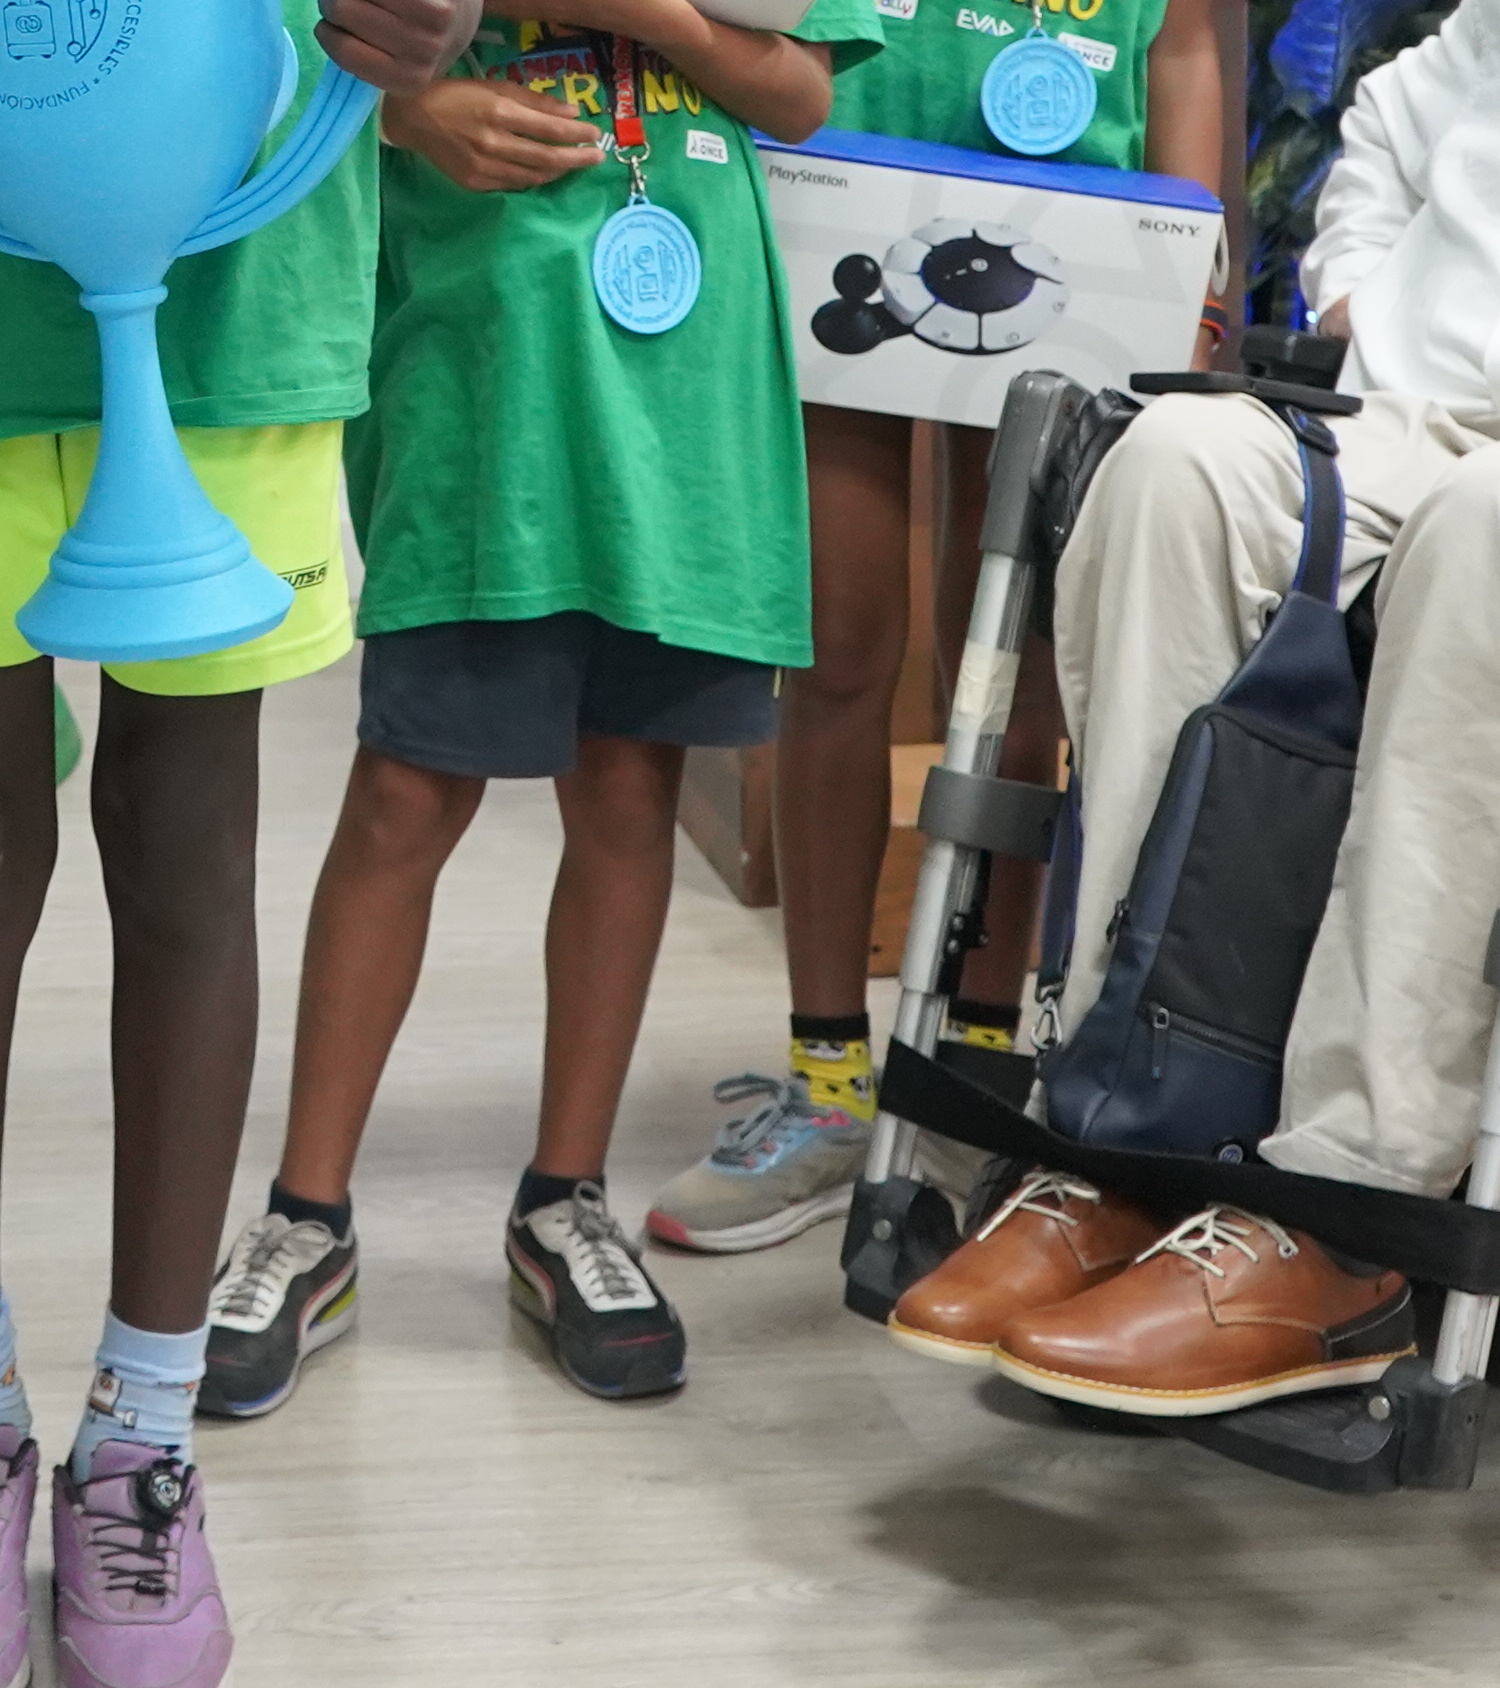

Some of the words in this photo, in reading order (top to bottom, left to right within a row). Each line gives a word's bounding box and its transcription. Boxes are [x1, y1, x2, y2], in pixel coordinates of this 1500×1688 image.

[1078, 50, 1110, 68] NCE
[767, 164, 848, 189] PlayStation
[1137, 217, 1202, 238] SONY
